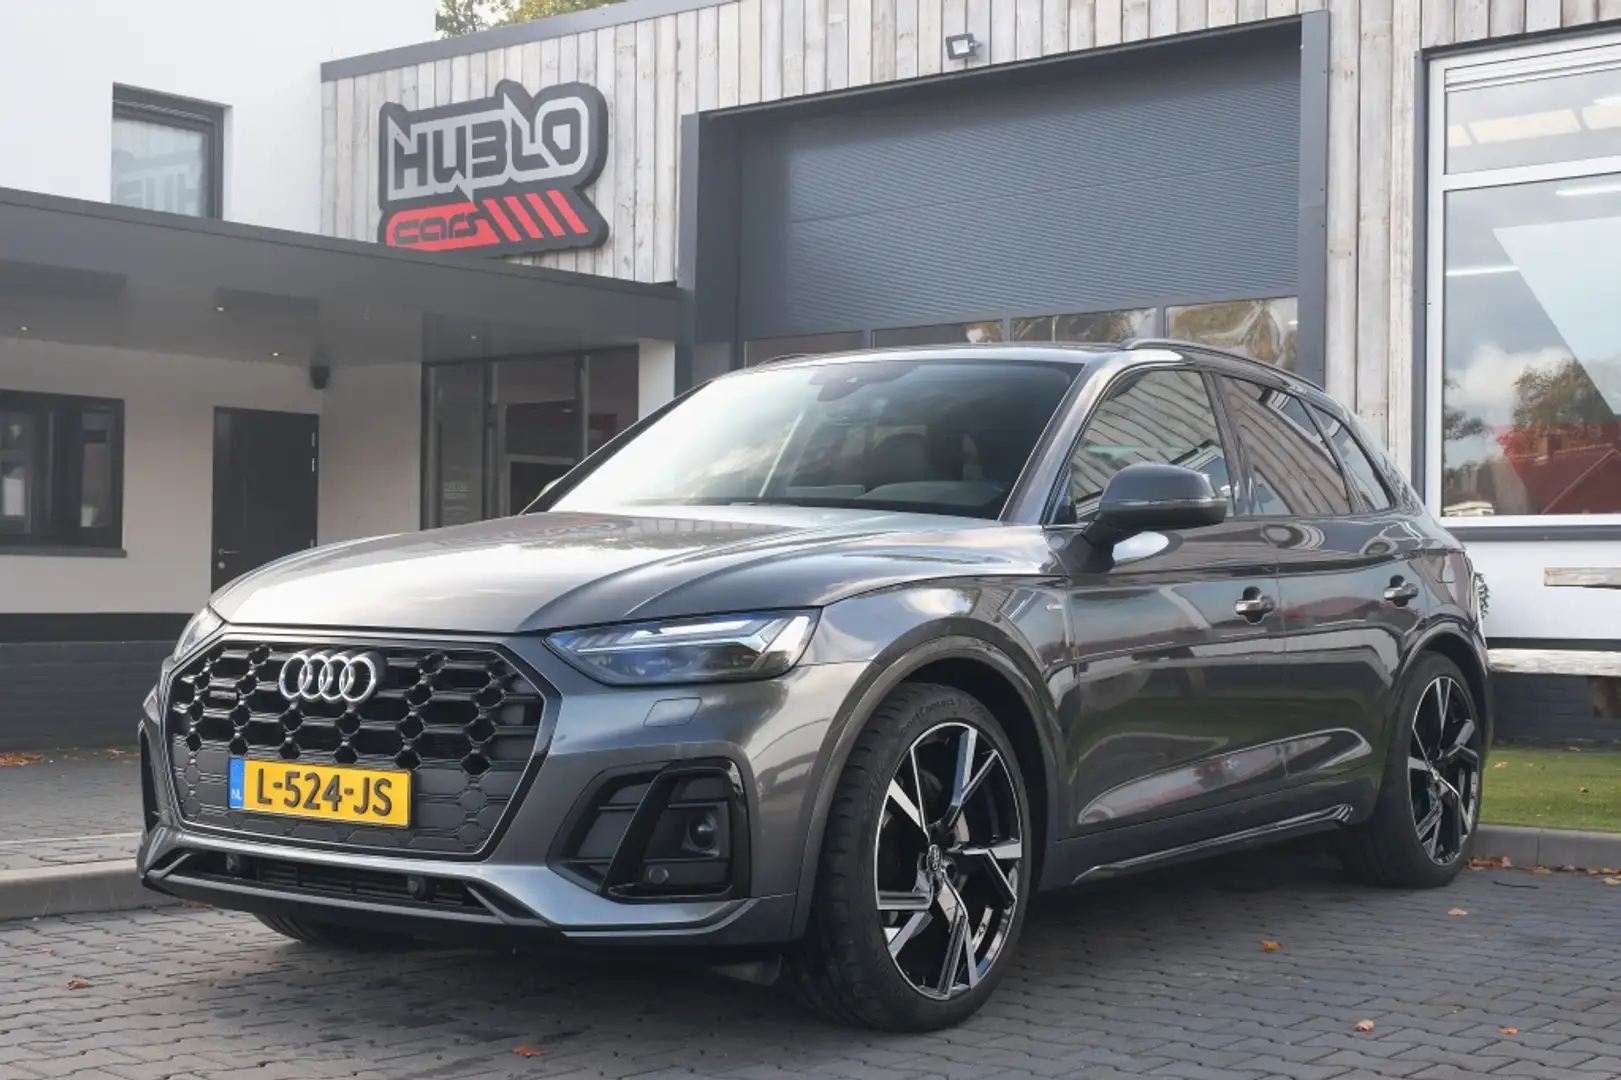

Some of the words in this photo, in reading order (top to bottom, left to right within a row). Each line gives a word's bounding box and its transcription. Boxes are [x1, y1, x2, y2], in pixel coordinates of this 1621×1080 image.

[387, 92, 589, 202] HUBLO
[231, 788, 243, 801] NL
[257, 768, 393, 817] L-524-JS
